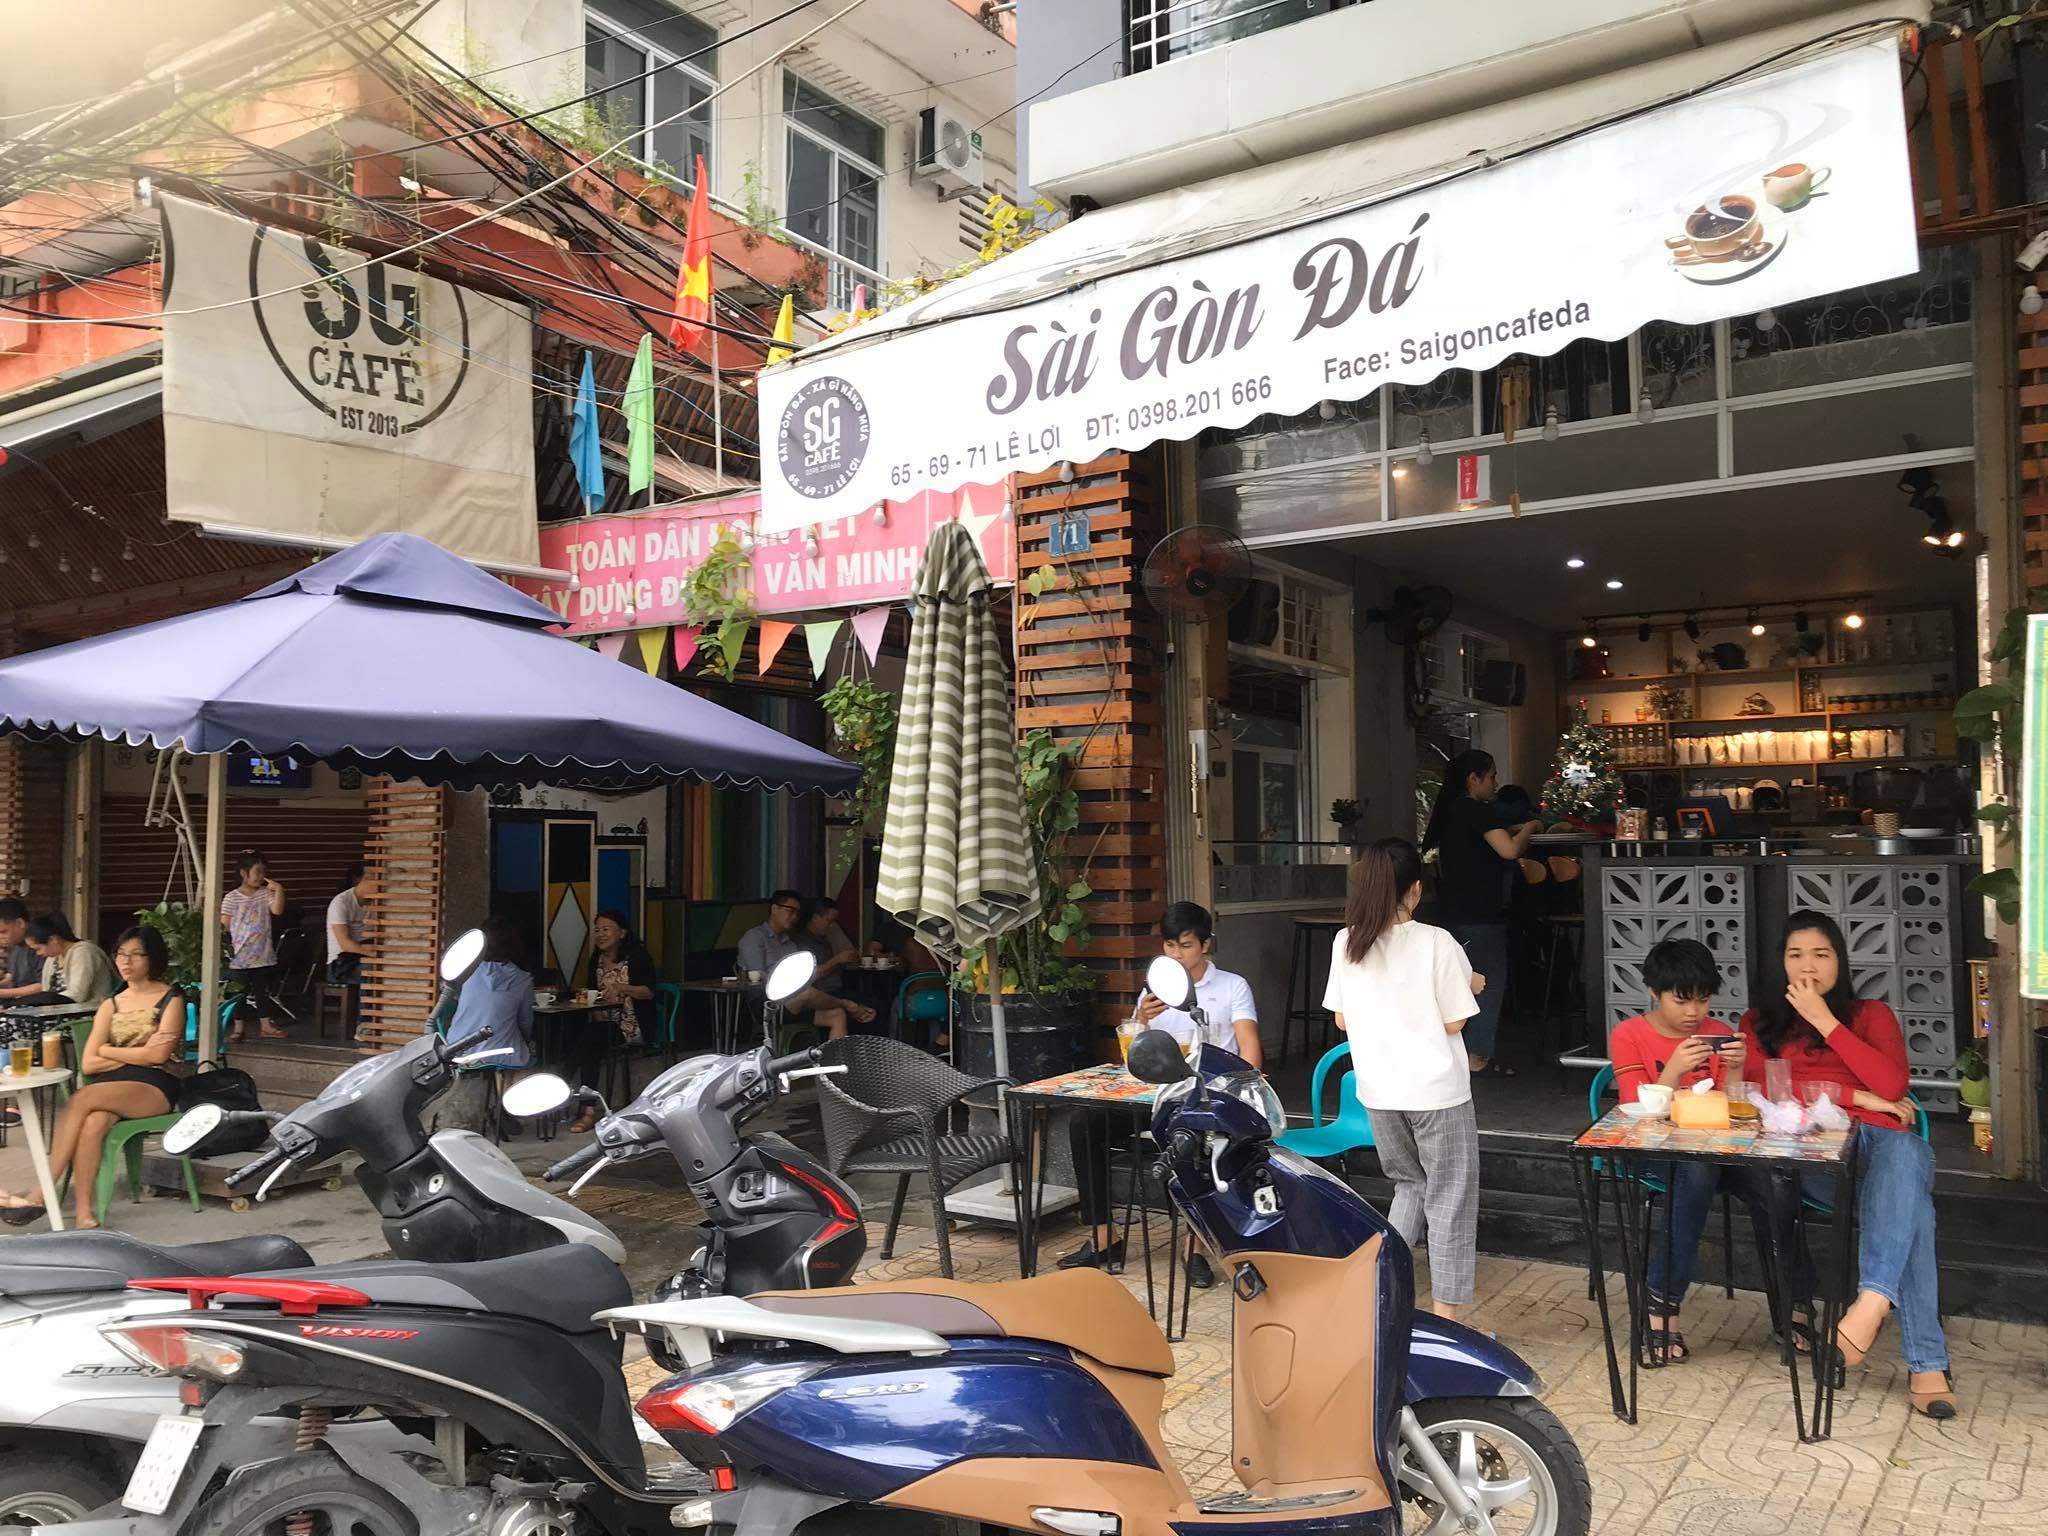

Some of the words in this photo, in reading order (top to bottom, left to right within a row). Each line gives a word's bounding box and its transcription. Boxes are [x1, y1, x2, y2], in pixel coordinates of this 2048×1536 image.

[986, 308, 1102, 415] Sài
[1120, 279, 1266, 381] Gòn
[1292, 212, 1431, 343] Đá
[1324, 350, 1390, 384] Face:
[1400, 299, 1591, 365] Saigoncafeda
[340, 405, 364, 431] EST
[367, 411, 398, 437] 2013
[803, 396, 841, 453] SG
[1085, 413, 1121, 441] ĐT:
[1127, 386, 1222, 432] 0398.201
[1231, 375, 1272, 406] 666
[891, 464, 911, 486] 65
[929, 454, 949, 478] 69
[967, 444, 986, 469] 71
[995, 431, 1020, 462] LÊ
[1028, 424, 1061, 456] LỢI
[565, 529, 636, 574] TOÀN
[644, 521, 700, 563] DÂN
[763, 551, 827, 595] VĂN
[836, 545, 919, 588] MINH
[297, 1324, 421, 1341] VISION
